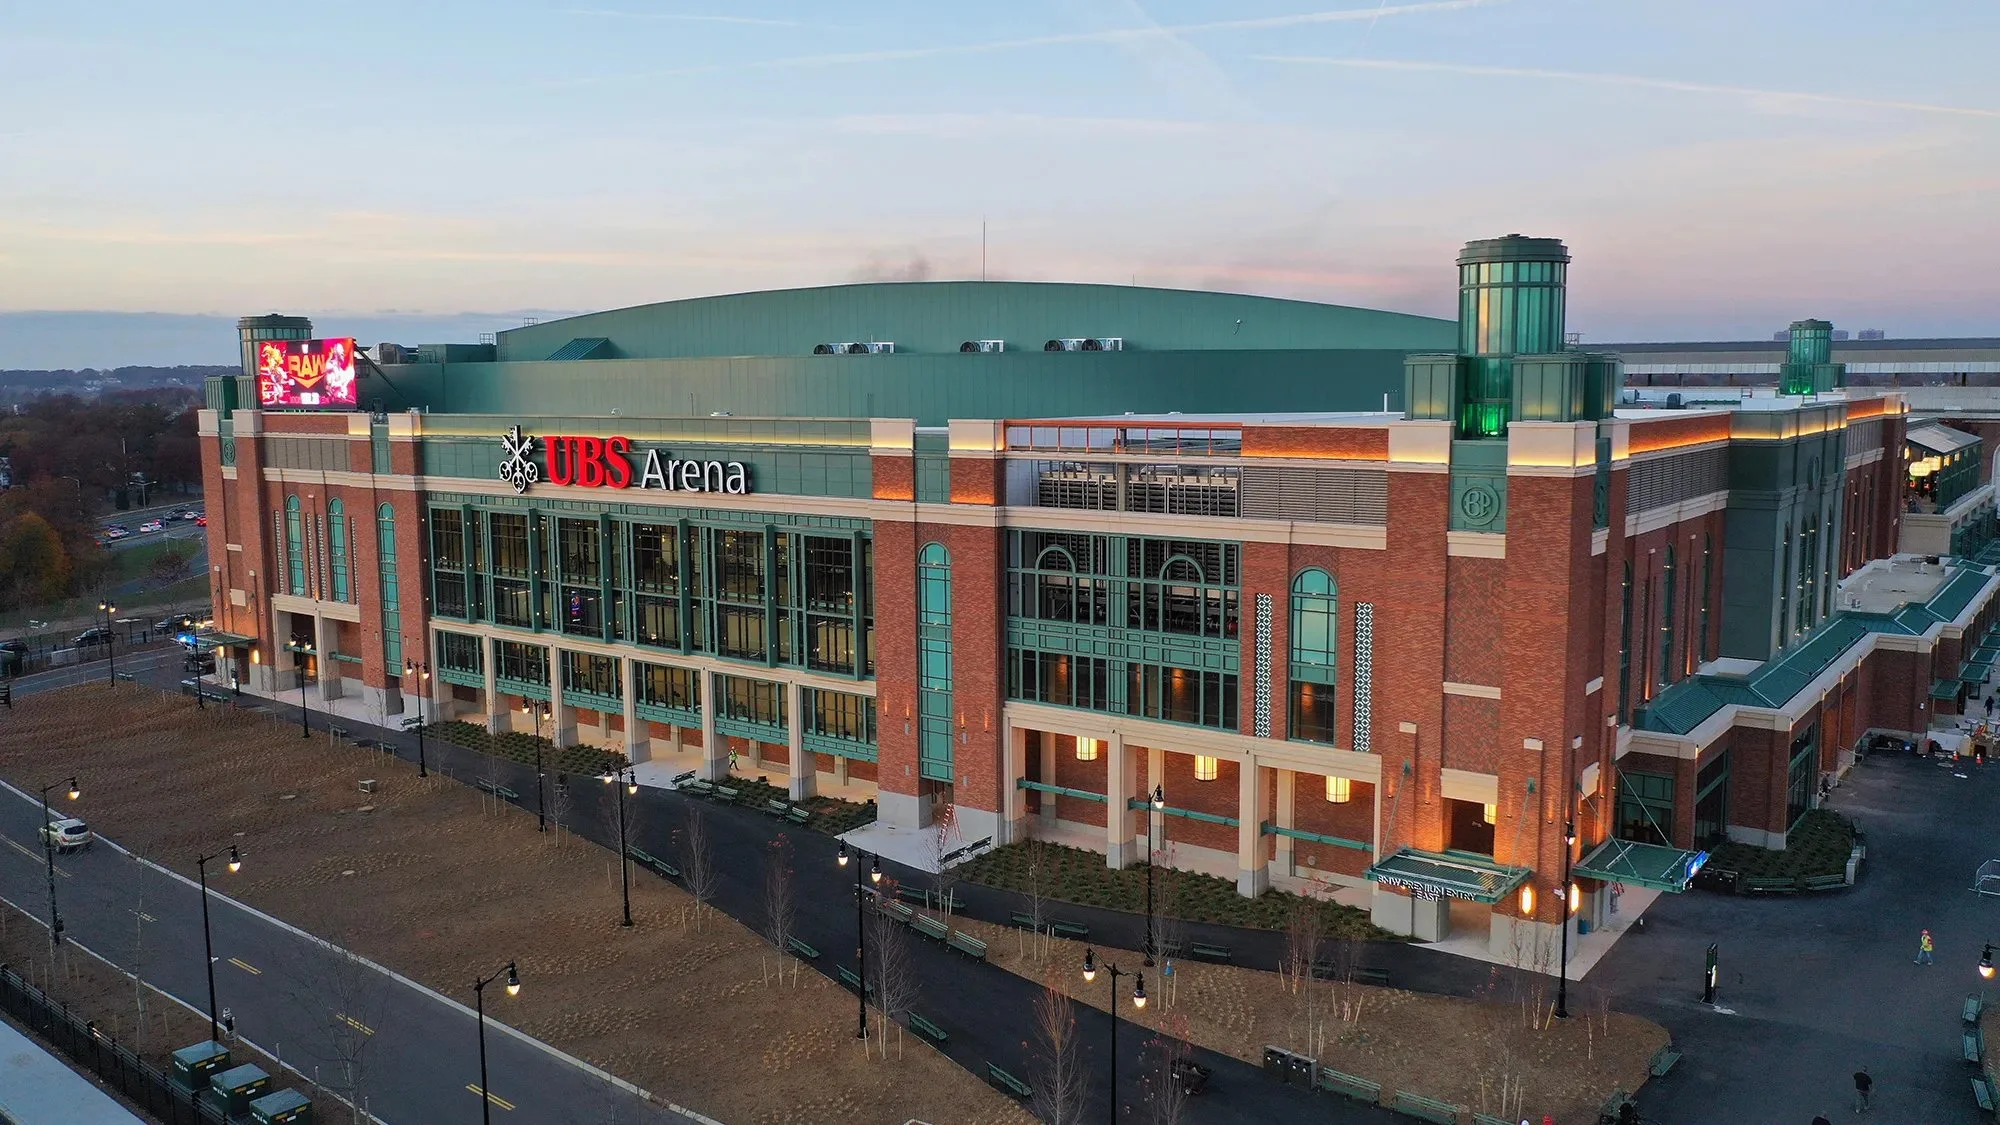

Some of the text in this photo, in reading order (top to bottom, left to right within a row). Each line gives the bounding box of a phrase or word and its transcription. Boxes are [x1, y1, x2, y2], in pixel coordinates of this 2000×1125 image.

[288, 354, 326, 378] RAW
[543, 436, 748, 494] UBS Arena
[1378, 874, 1476, 901] BMW PREMIUM ENTRY
[1416, 890, 1439, 902] EAST
